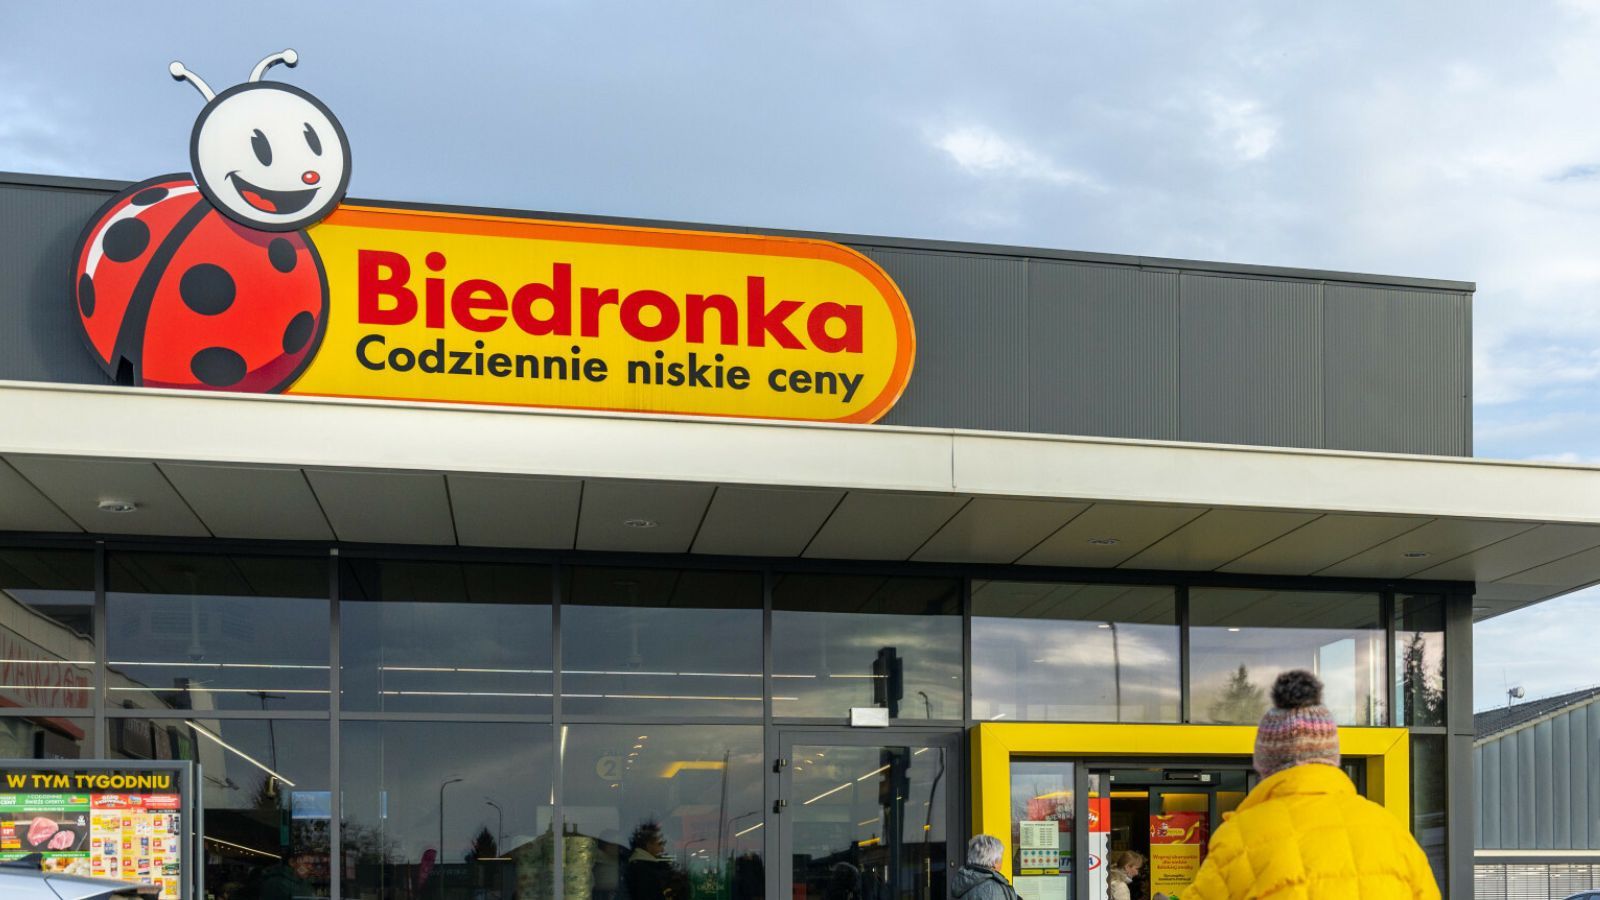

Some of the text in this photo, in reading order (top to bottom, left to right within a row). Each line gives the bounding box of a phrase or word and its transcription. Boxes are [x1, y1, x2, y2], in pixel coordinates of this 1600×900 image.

[358, 249, 864, 353] Biedronka
[356, 335, 864, 402] Codziennie niskie ceny
[6, 775, 170, 789] W TYM TYGODNIU
